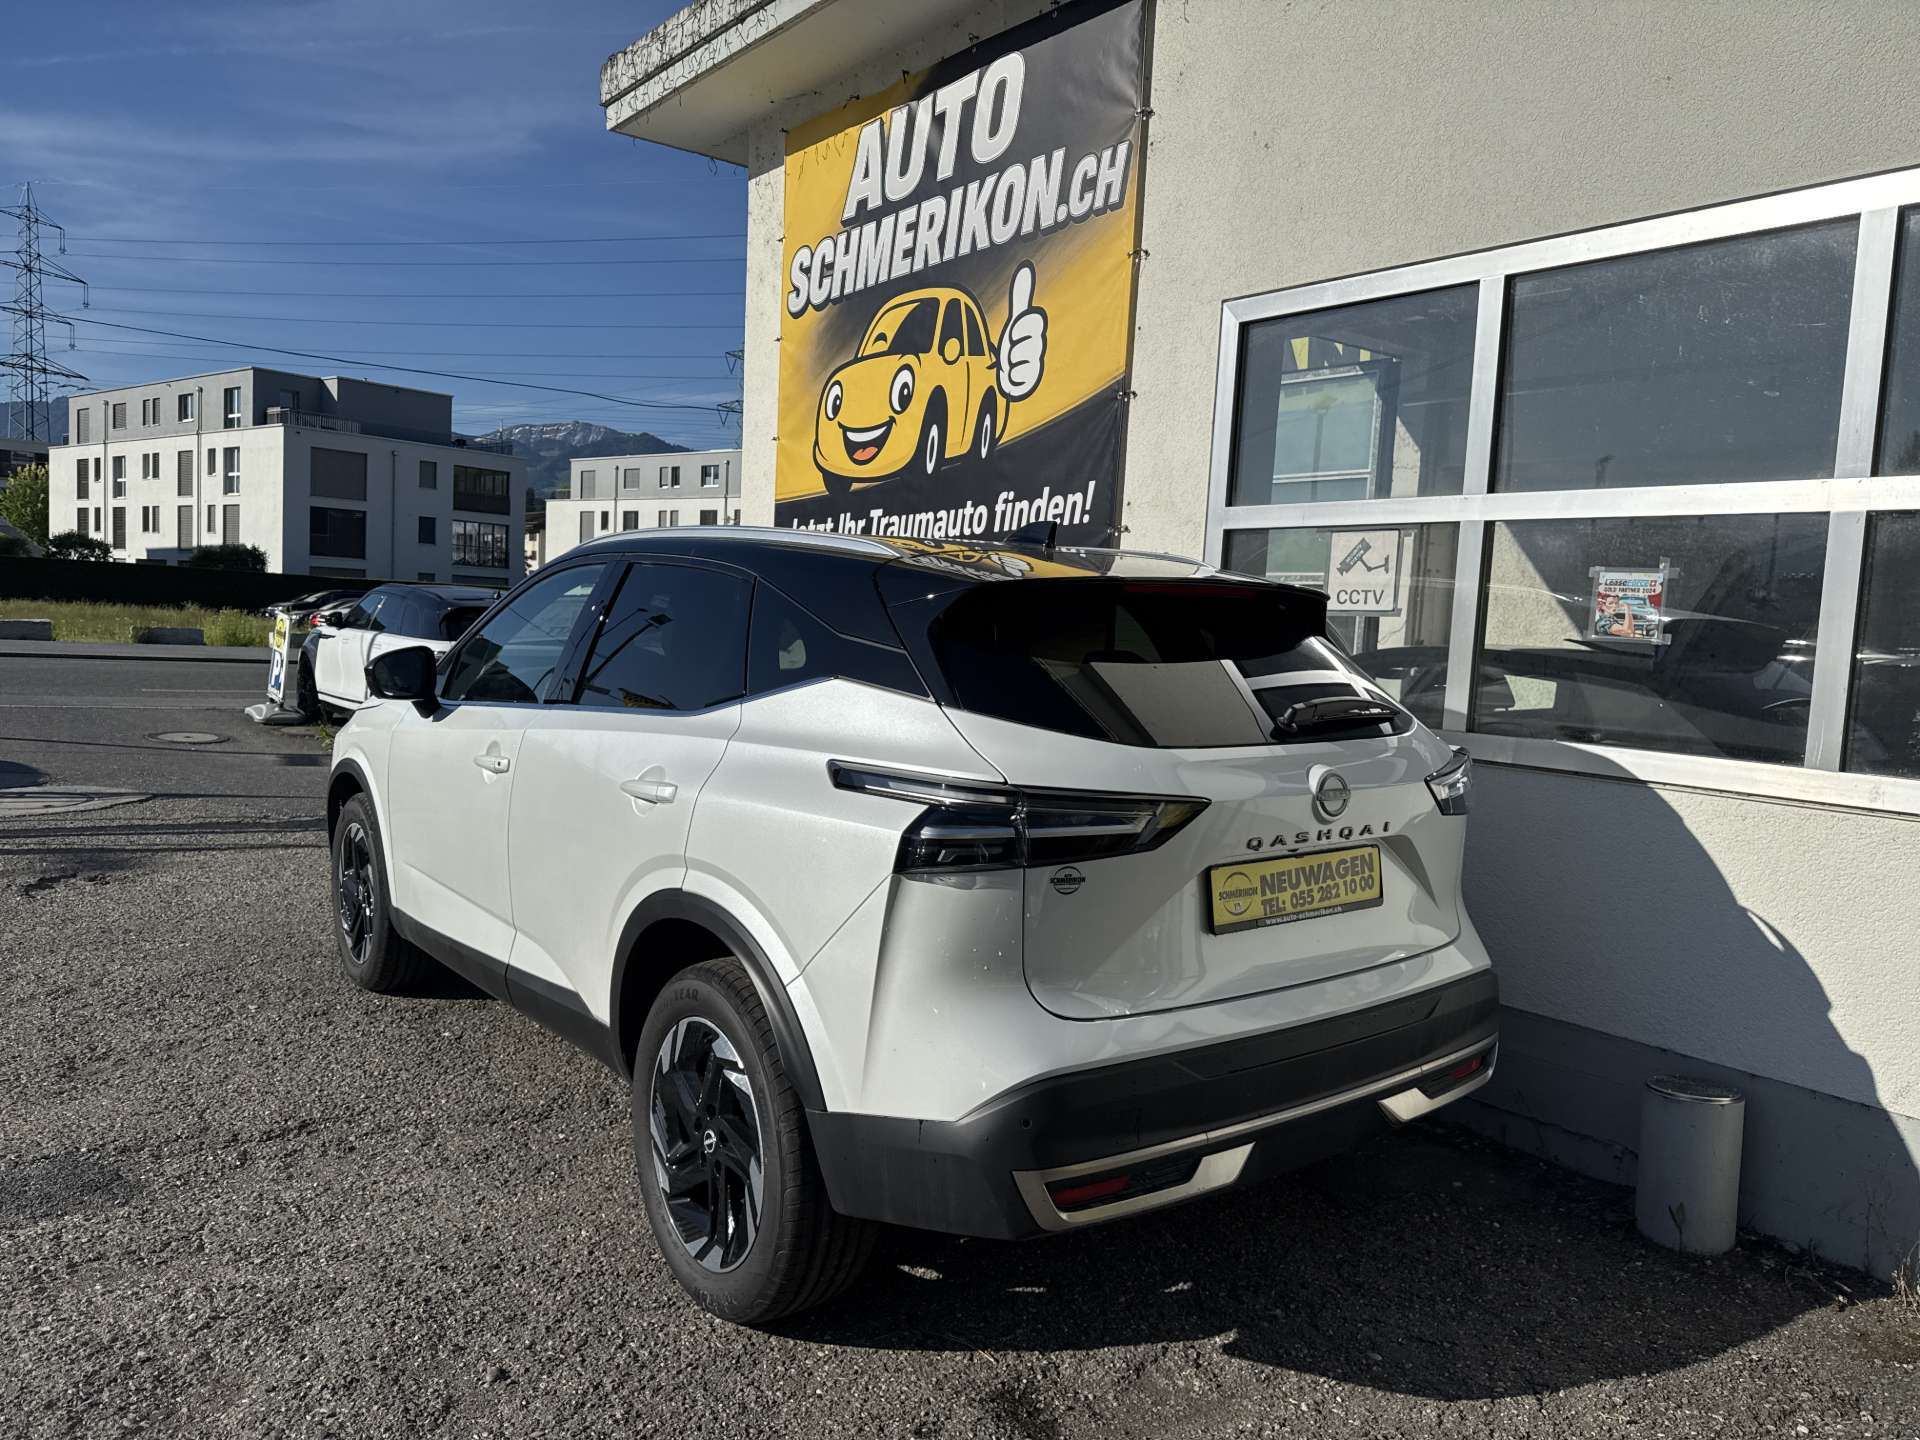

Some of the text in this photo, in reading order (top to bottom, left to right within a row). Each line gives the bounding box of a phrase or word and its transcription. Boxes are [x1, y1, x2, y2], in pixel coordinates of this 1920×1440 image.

[841, 51, 1025, 224] AUTO
[787, 141, 1132, 316] SCHMERIKON.CH
[838, 480, 1096, 539] Ihr Traumauto finden!
[1336, 589, 1384, 605] CCTV
[1246, 821, 1391, 851] QASHQAI
[1259, 852, 1374, 897] NEUWAGEN
[1261, 898, 1287, 916] TEL:
[1290, 888, 1315, 910] 055
[1317, 882, 1341, 901] 282
[1343, 878, 1358, 896] 10
[1358, 874, 1375, 892] 00
